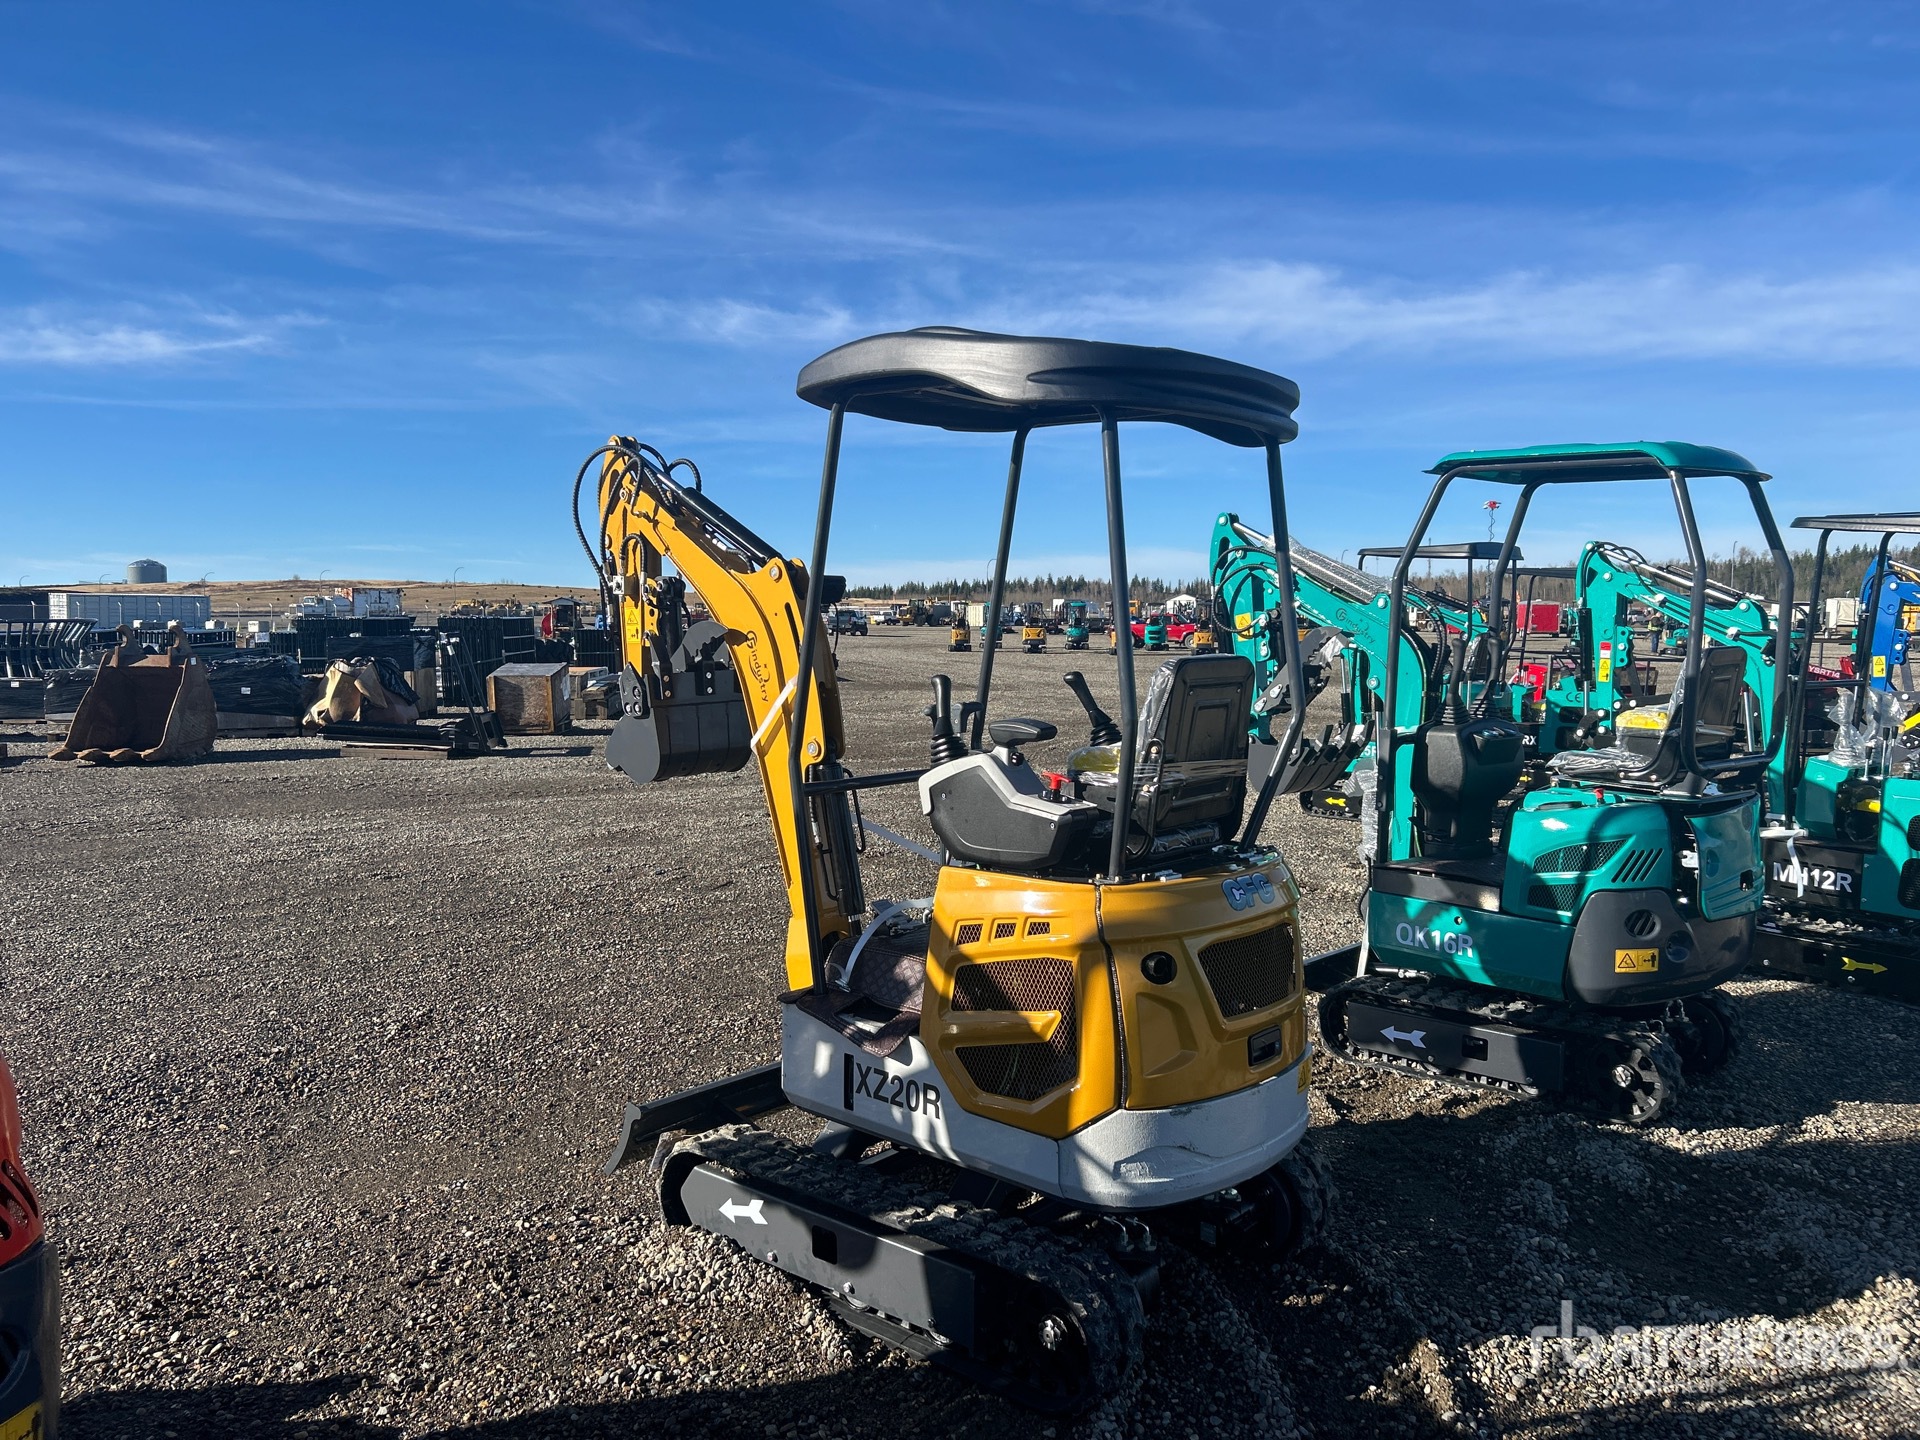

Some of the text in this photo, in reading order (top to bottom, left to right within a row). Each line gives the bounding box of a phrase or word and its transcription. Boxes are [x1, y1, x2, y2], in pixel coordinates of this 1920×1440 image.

[1221, 872, 1276, 912] CFG
[1773, 862, 1853, 893] MH12R
[1395, 922, 1474, 958] QK16R
[855, 1062, 941, 1120] XZ20R
